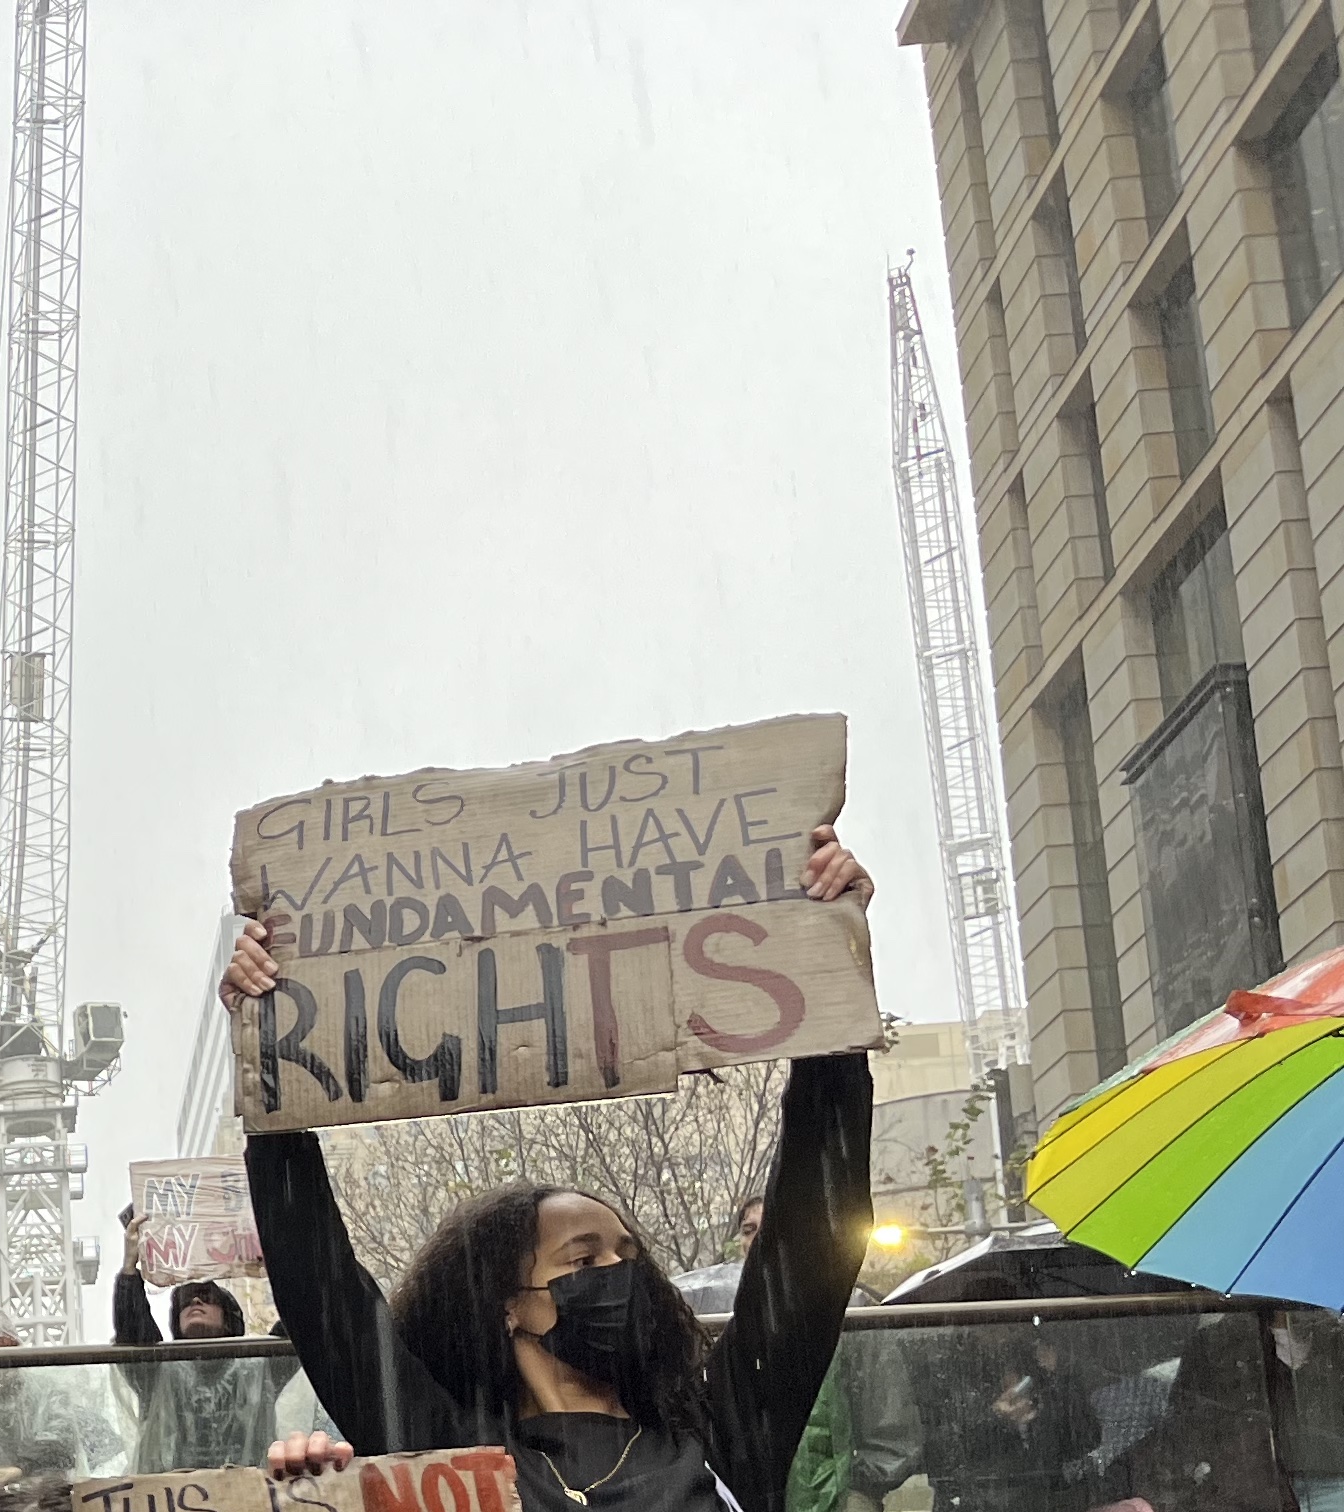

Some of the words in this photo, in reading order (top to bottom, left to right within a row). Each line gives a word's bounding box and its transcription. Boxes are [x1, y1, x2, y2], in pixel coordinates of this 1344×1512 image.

[257, 781, 466, 842] GIRLS
[530, 745, 723, 820] JUST
[261, 832, 534, 913] WANNA
[580, 787, 803, 870] HAVE
[265, 847, 809, 958] FUNDAMENTAL
[258, 912, 806, 1114] RIGHTS
[142, 1172, 202, 1223] MY
[142, 1222, 200, 1275] MY
